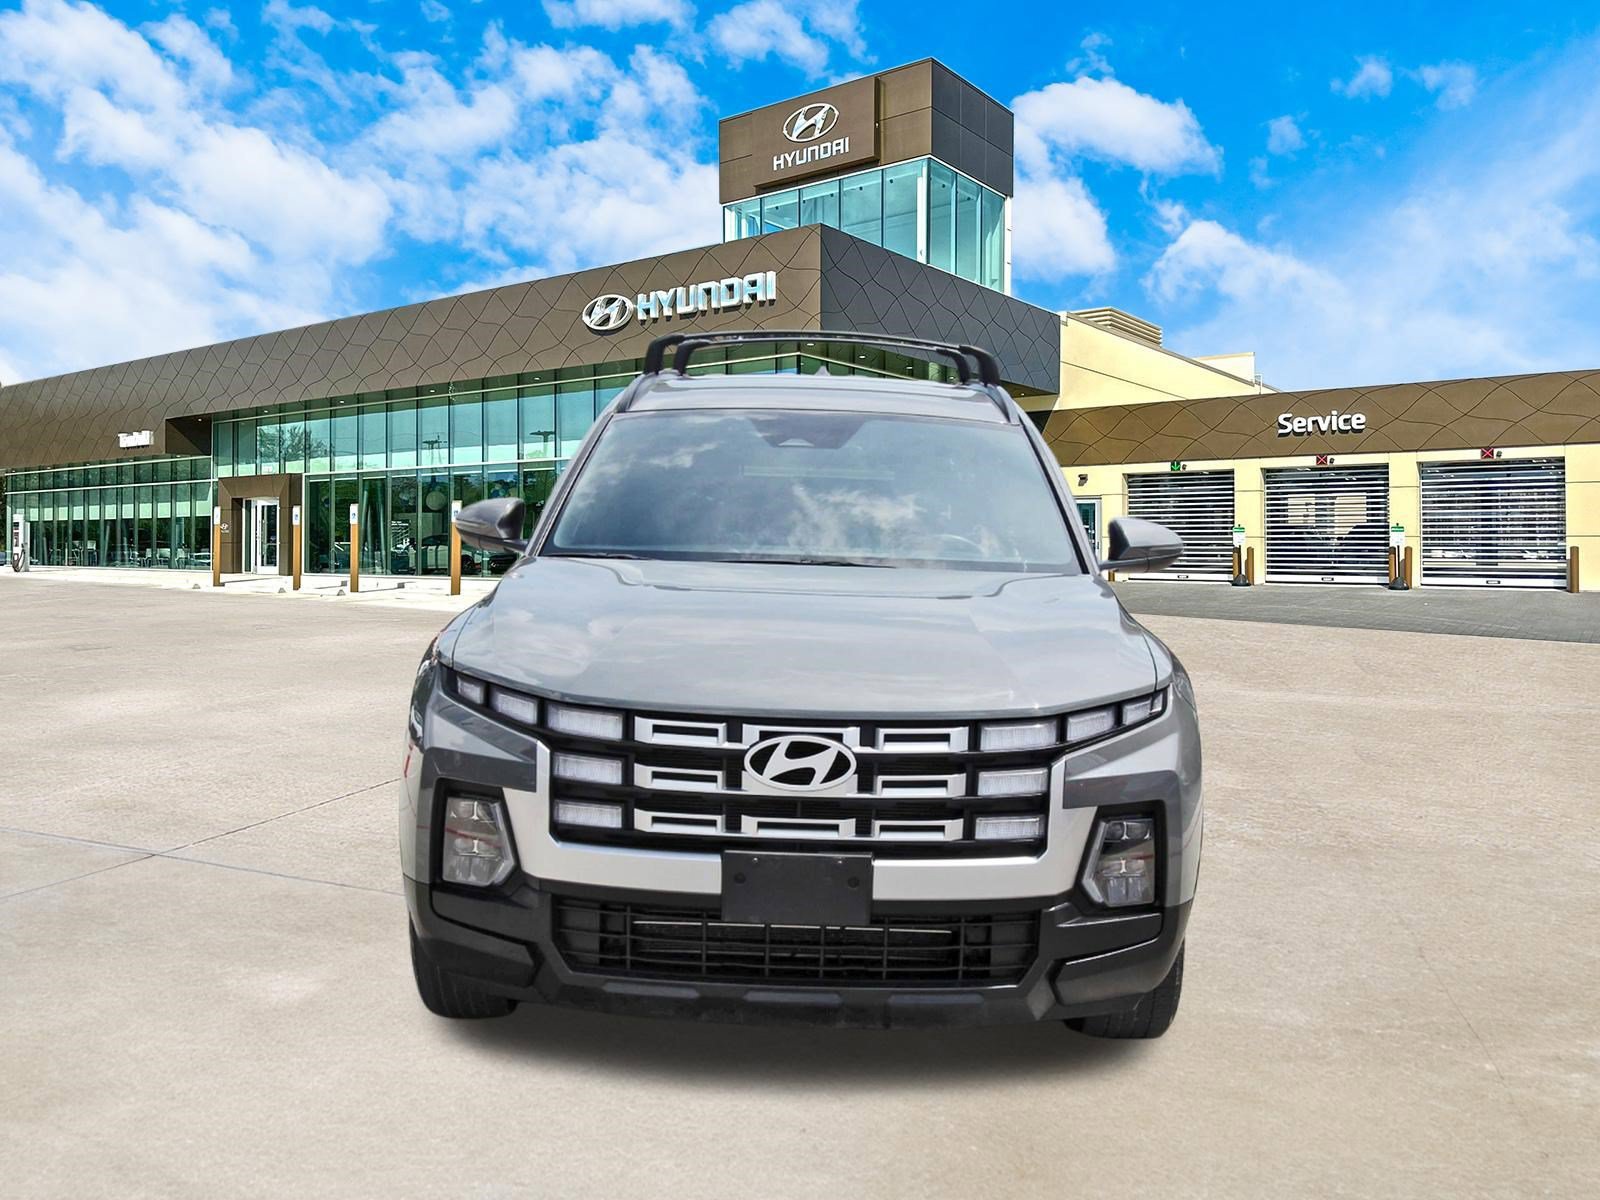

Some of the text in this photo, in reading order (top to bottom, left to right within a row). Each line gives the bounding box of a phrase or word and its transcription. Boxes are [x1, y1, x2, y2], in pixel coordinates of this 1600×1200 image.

[773, 136, 849, 171] HYUNDAI
[636, 270, 777, 321] HYUNDAI
[1277, 409, 1366, 434] Service
